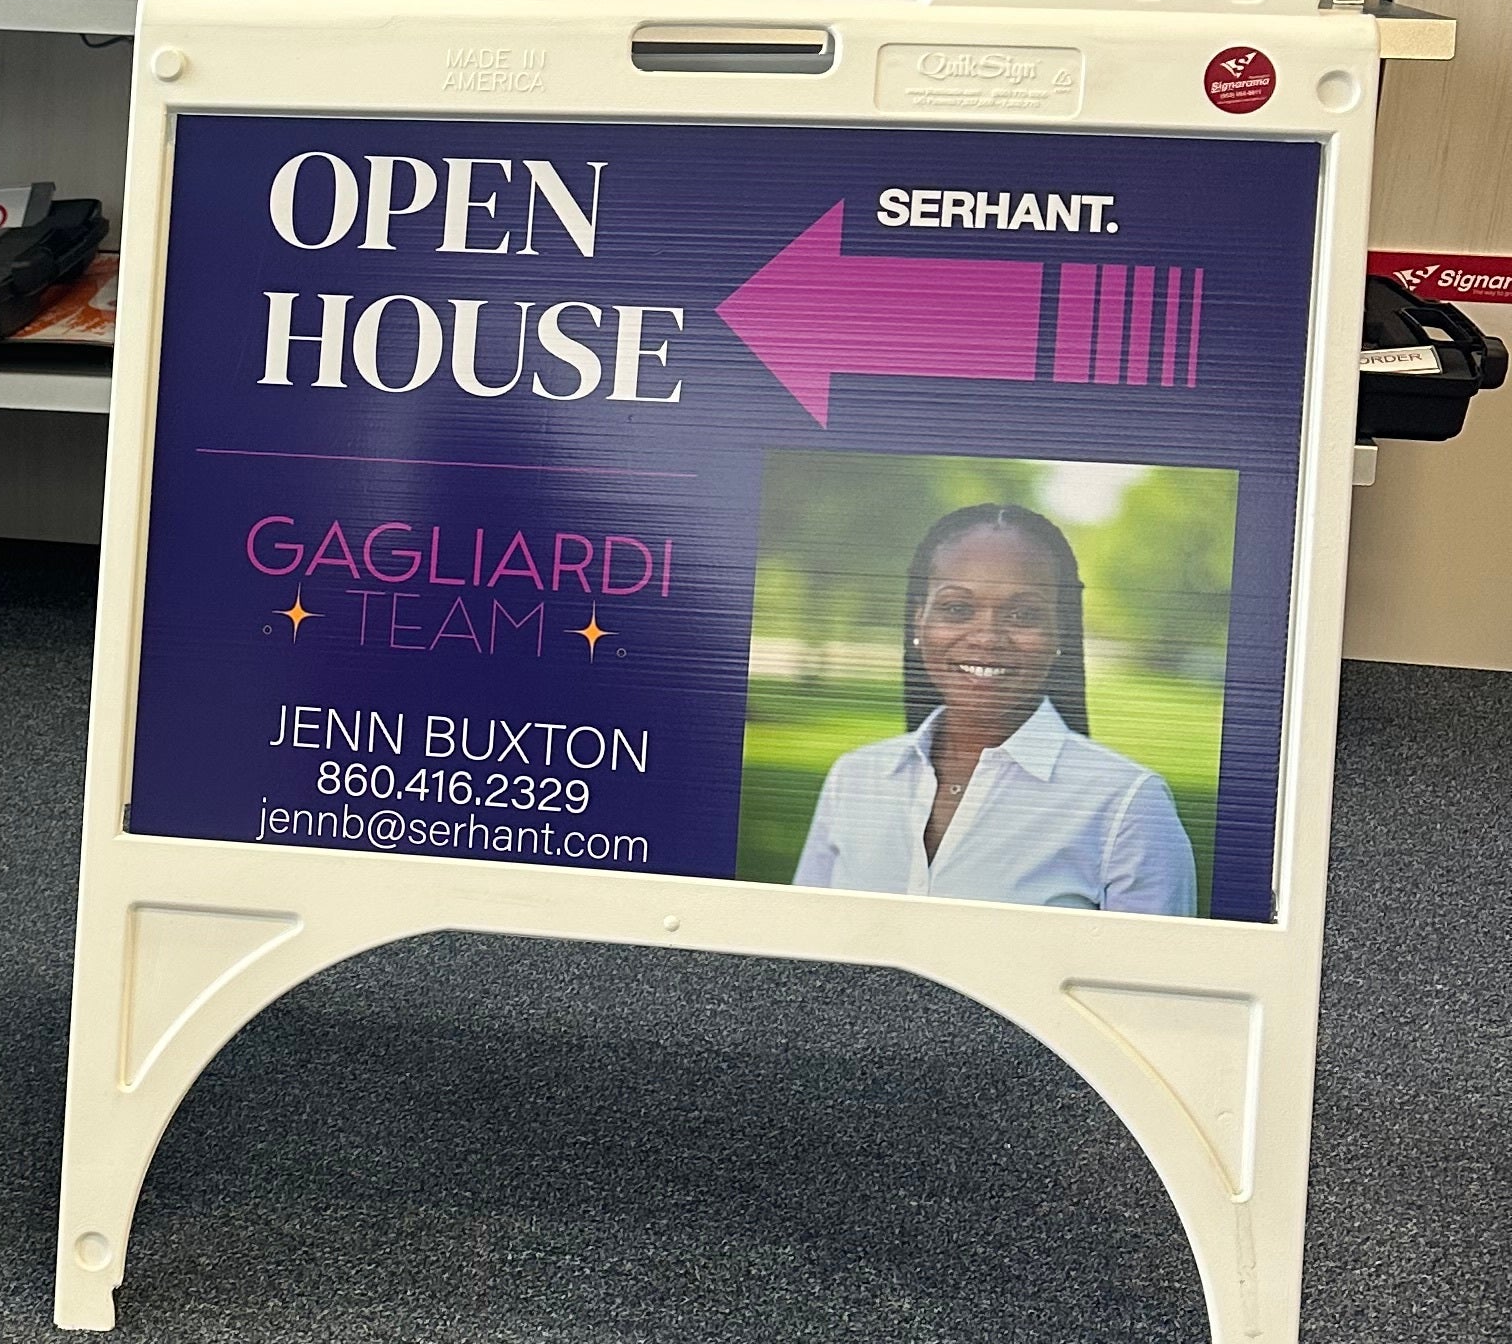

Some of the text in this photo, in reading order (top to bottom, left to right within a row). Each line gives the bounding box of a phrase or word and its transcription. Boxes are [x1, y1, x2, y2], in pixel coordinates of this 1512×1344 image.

[442, 71, 546, 93] AMERICA
[445, 49, 546, 70] MADE IN
[917, 52, 1037, 85] QuikSign
[269, 151, 609, 258] OPEN
[876, 188, 1119, 234] SERHANT.
[1437, 269, 1512, 292] Signar
[257, 291, 684, 403] HOUSE
[246, 515, 674, 598] GAGLIARDI
[345, 589, 545, 657] TEAM
[269, 704, 649, 774] JENN BUXTON
[316, 761, 589, 814] 860.416.2329
[255, 797, 649, 863] jennb@serhant.com
